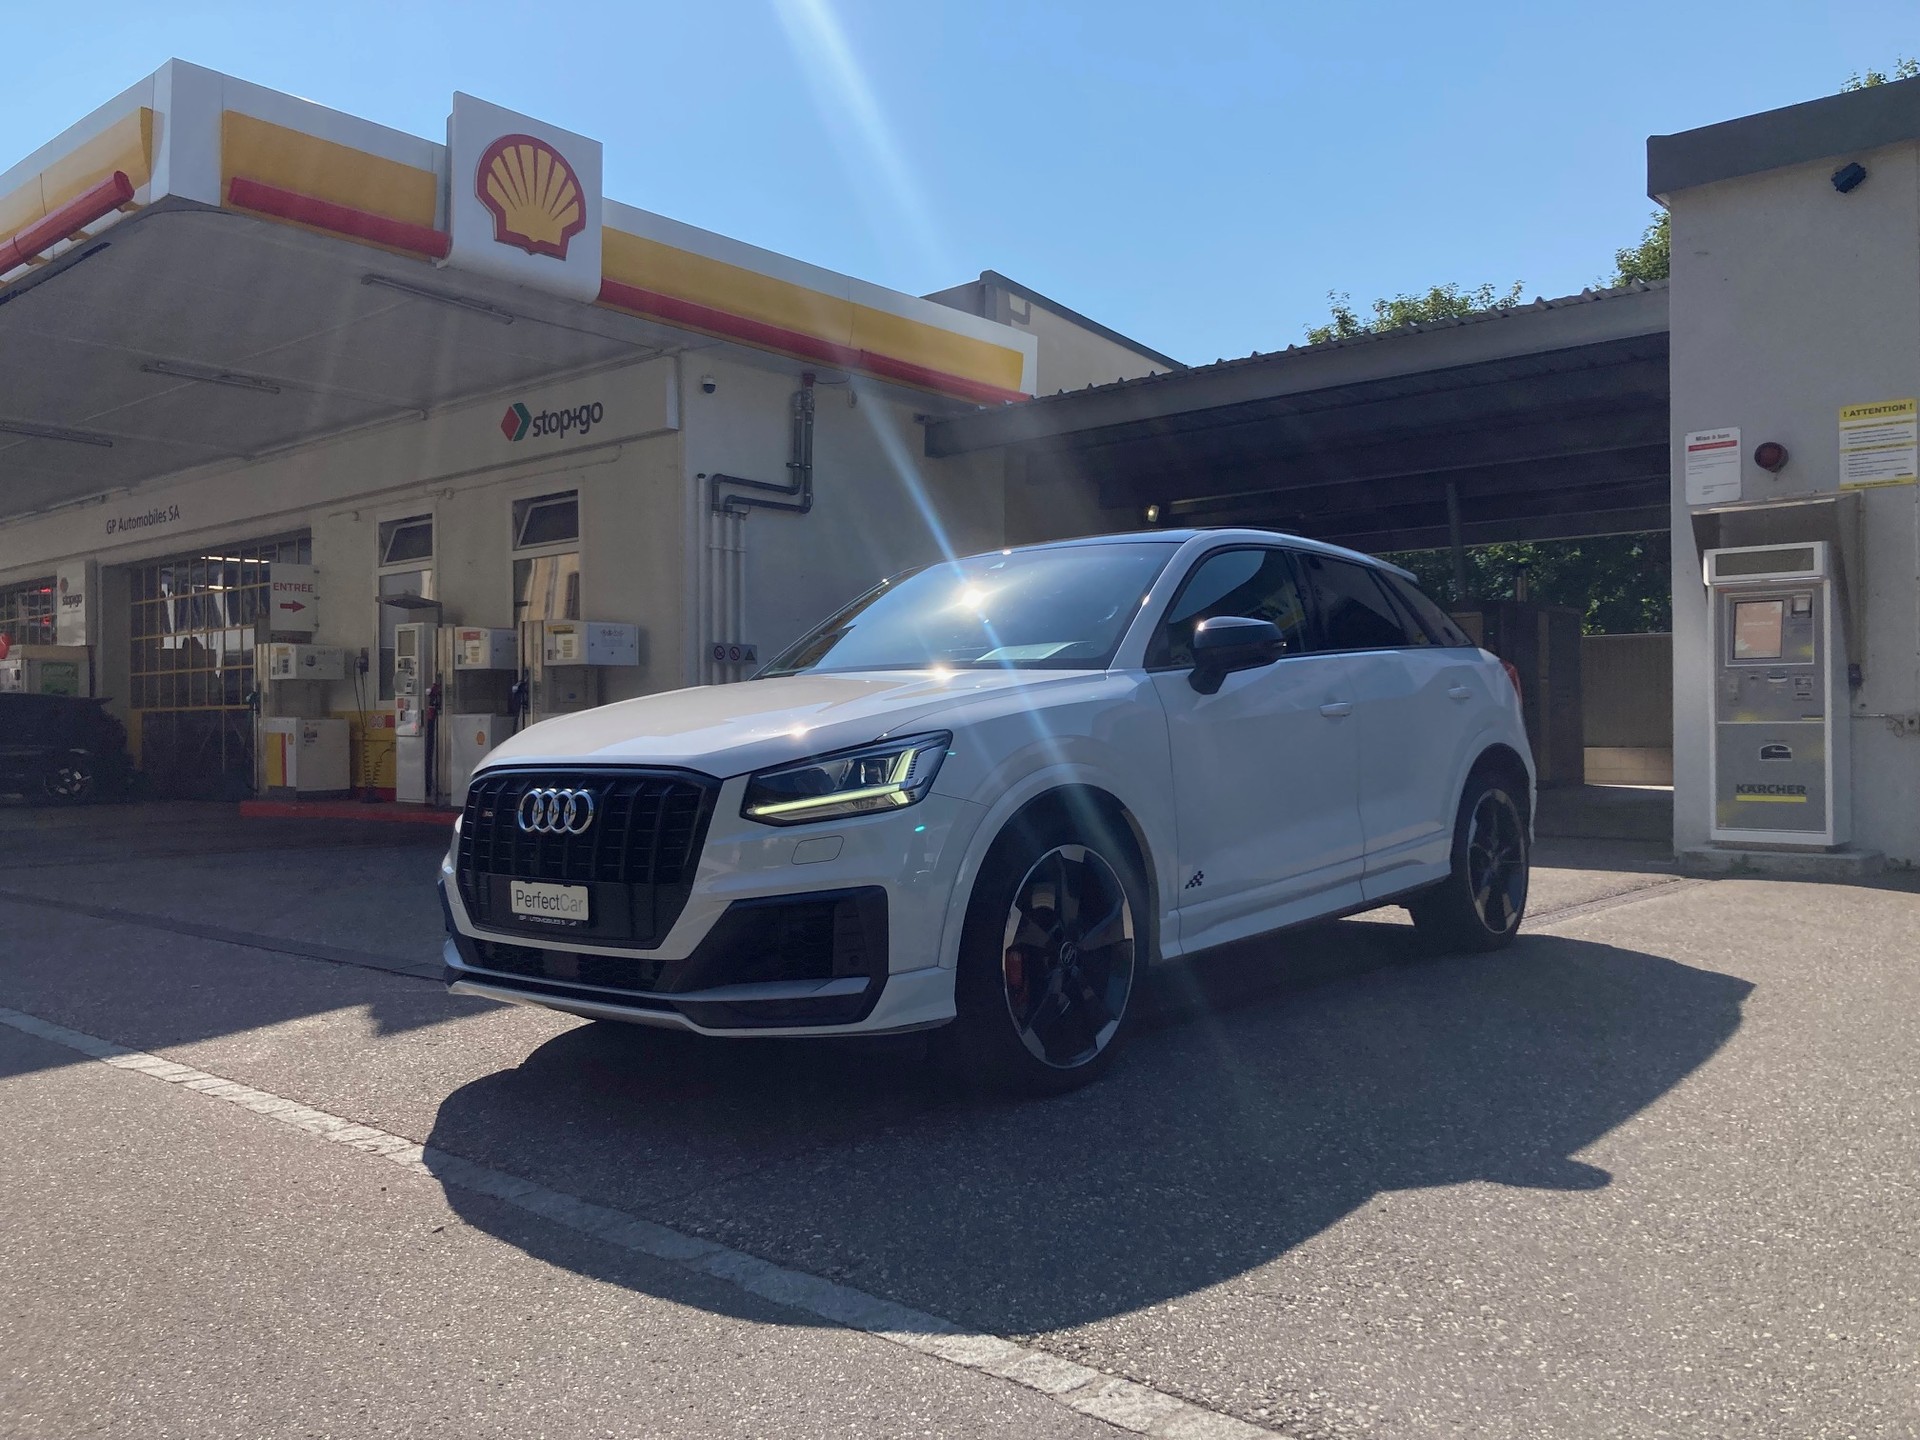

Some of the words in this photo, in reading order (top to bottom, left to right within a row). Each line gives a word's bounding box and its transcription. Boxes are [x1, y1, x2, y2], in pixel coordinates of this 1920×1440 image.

[532, 401, 604, 440] stop+go
[1849, 404, 1907, 417] ATTENTION
[106, 519, 117, 535] GP
[118, 508, 167, 532] Automobiles
[168, 504, 181, 522] SA
[515, 889, 583, 913] PerfectCar
